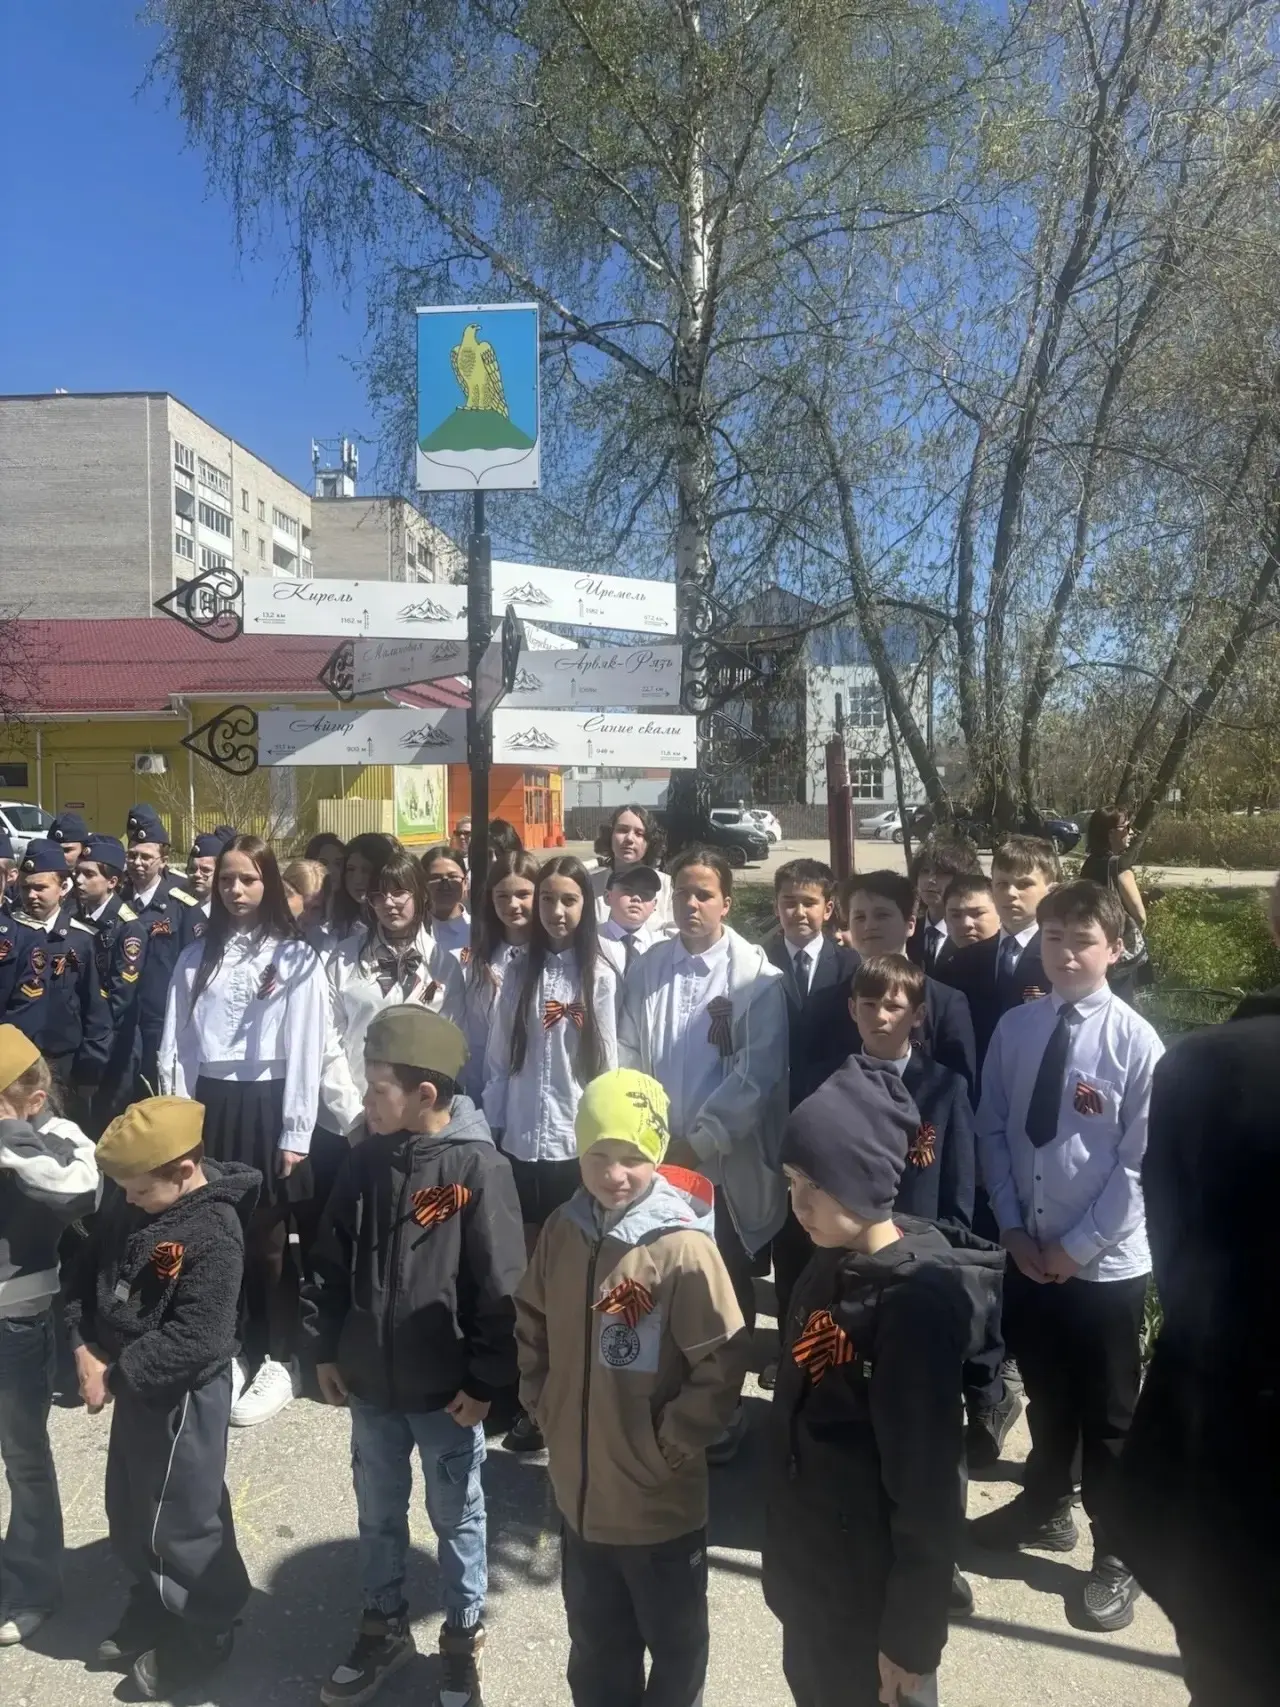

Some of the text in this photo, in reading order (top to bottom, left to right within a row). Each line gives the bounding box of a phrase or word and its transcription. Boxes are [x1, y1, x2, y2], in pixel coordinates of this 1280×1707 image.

[272, 581, 354, 606] Кирель
[574, 578, 647, 602] Иремель
[341, 617, 355, 625] 1162
[554, 650, 673, 675] Арвяк-Рязь
[288, 715, 355, 737] Айгир
[576, 715, 682, 736] Синие скалы
